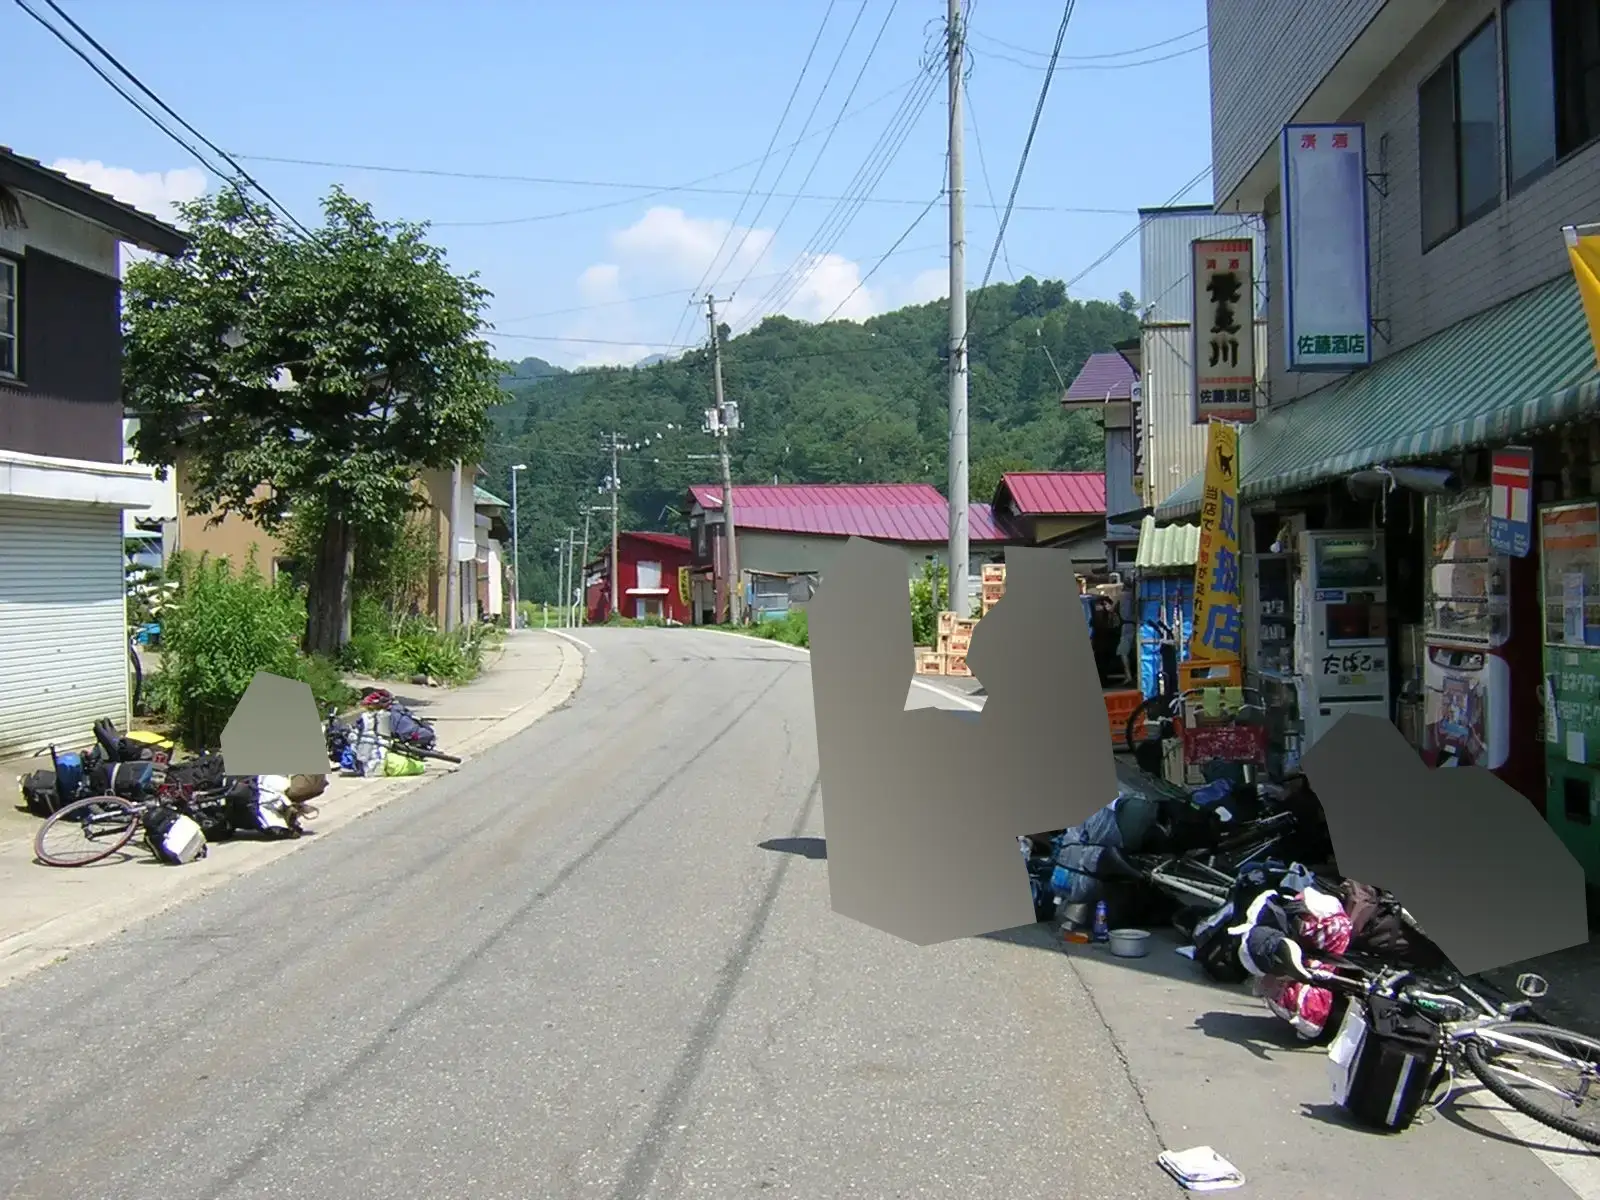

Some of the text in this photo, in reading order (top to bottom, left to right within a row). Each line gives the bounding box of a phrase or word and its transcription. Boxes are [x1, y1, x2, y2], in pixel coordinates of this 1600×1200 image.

[1297, 334, 1365, 356] 佐藤酒店
[1322, 651, 1372, 675] たばこ
